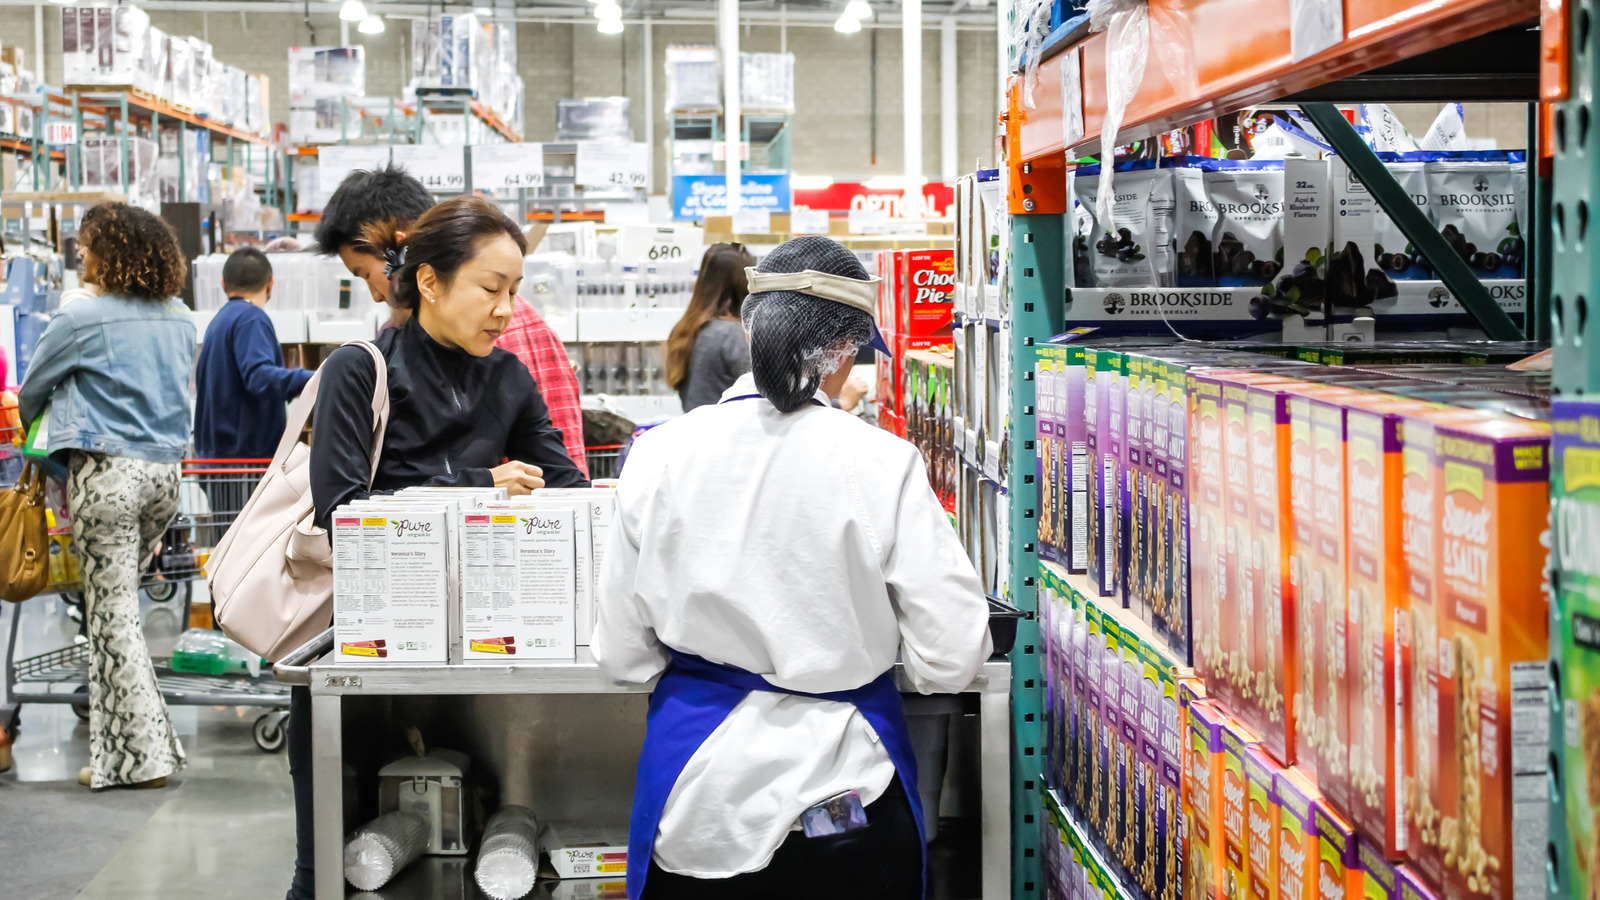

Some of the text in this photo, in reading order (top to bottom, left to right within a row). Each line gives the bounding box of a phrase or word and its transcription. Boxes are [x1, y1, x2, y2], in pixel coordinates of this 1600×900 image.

[504, 174, 541, 186] 64.99
[608, 172, 645, 185] 42.99
[1295, 181, 1307, 189] 32
[914, 288, 945, 304] Pie
[1130, 292, 1233, 309] BROOKSIDE
[397, 519, 433, 537] pure
[526, 516, 562, 535] pure
[1442, 495, 1491, 546] Sweet
[1249, 801, 1271, 845] Sweet
[570, 850, 595, 862] pure
[1280, 830, 1306, 878] Sweet
